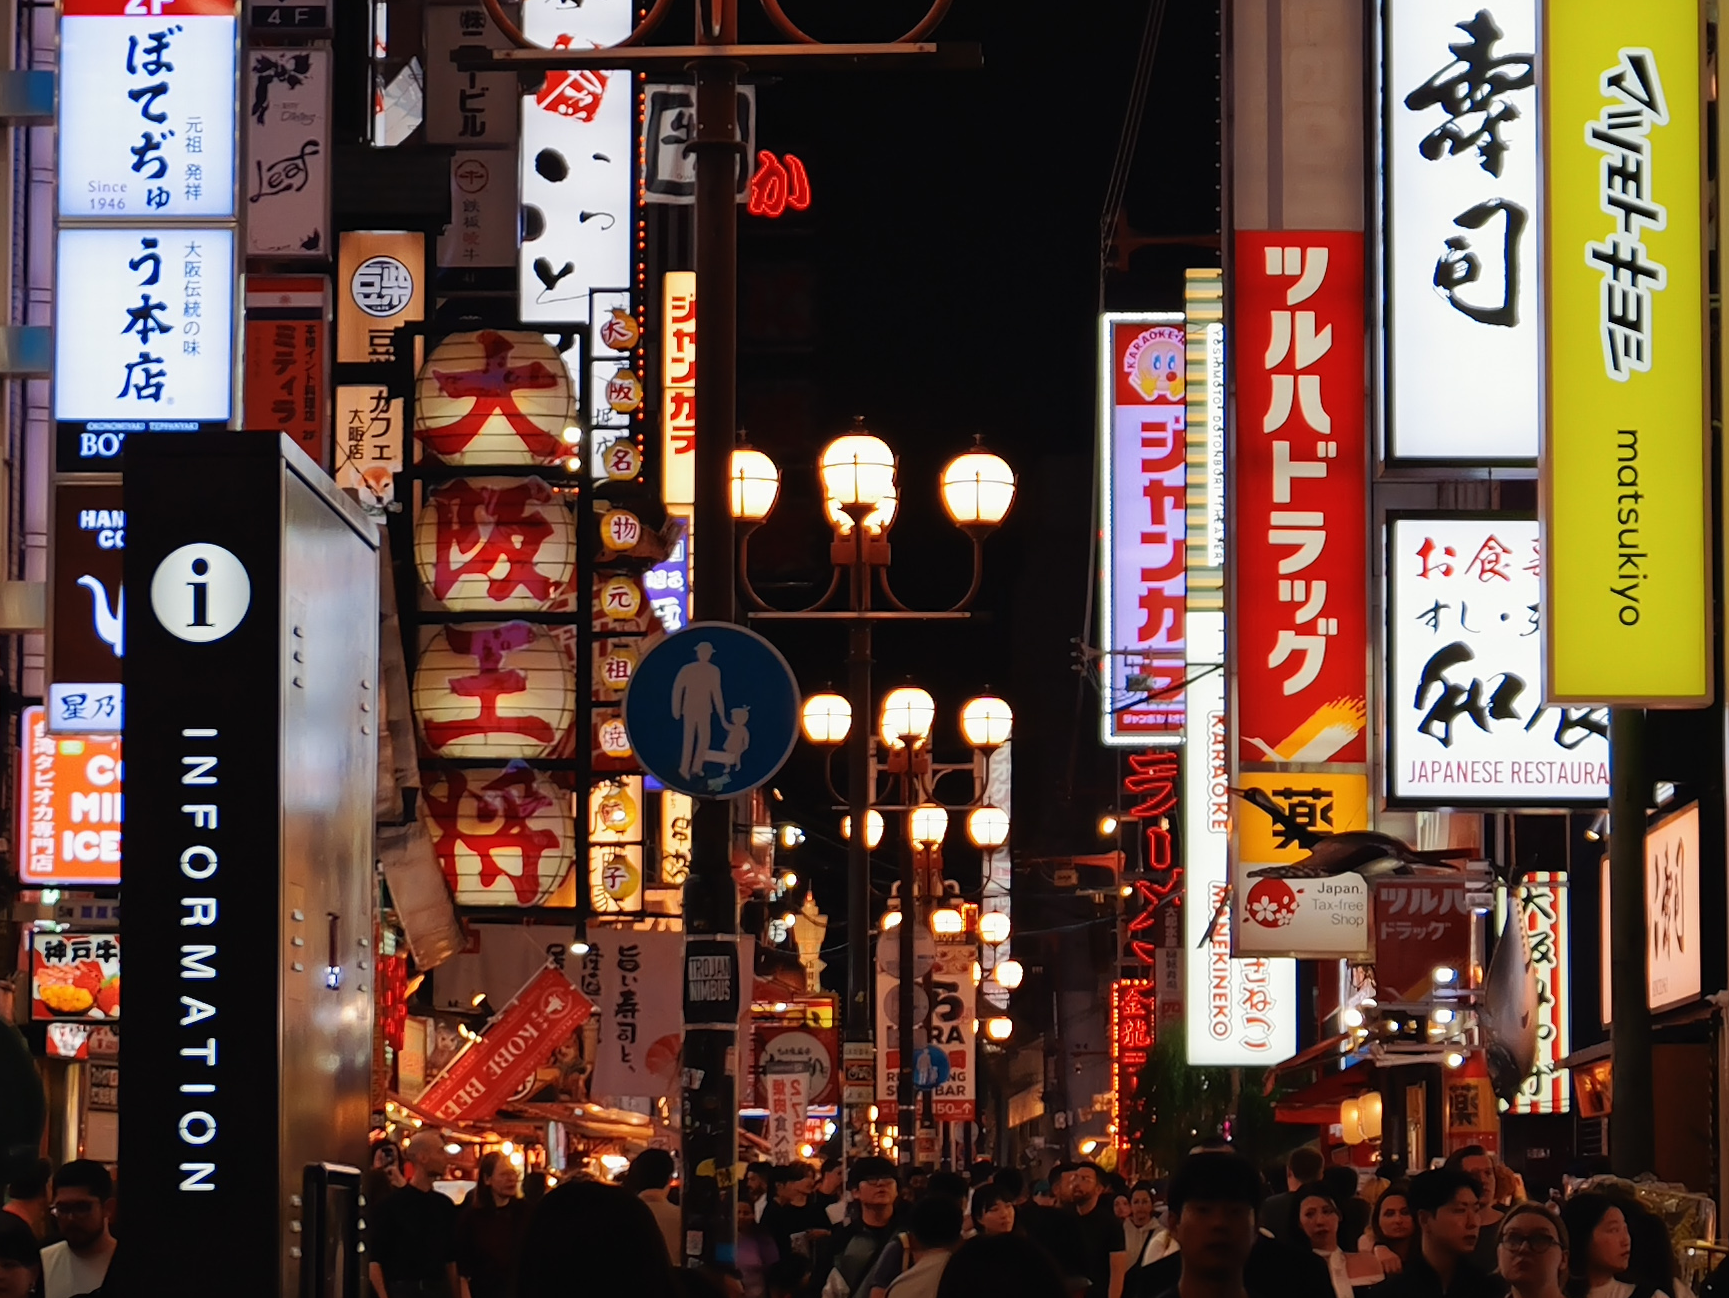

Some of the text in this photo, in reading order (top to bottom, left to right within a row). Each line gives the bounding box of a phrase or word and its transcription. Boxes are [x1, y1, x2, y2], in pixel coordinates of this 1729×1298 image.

[185, 116, 203, 201] 元祖 発祥
[250, 139, 320, 202] Leaf
[88, 180, 127, 193] Since
[89, 197, 126, 210] 1946
[183, 241, 202, 357] 大阪伝統の味
[349, 409, 365, 461] 大阪店
[371, 389, 398, 461] カフェ
[1264, 246, 1337, 696] ツルハドラッグ
[1610, 429, 1647, 628] matsukiyo
[59, 693, 117, 720] 星乃
[1208, 711, 1228, 833] KARAOKE
[1409, 760, 1504, 785] JAPANESE
[1317, 882, 1363, 897] Japan.
[1312, 898, 1363, 911] Tax-free
[1331, 913, 1363, 928] Shop
[1380, 922, 1451, 941] ドラッグ
[45, 940, 117, 962] 神戸牛
[179, 728, 218, 1194] INFORMATION
[688, 956, 731, 981] TROJAN
[689, 981, 730, 1001] NIMBUS
[483, 1023, 540, 1080] KOBE
